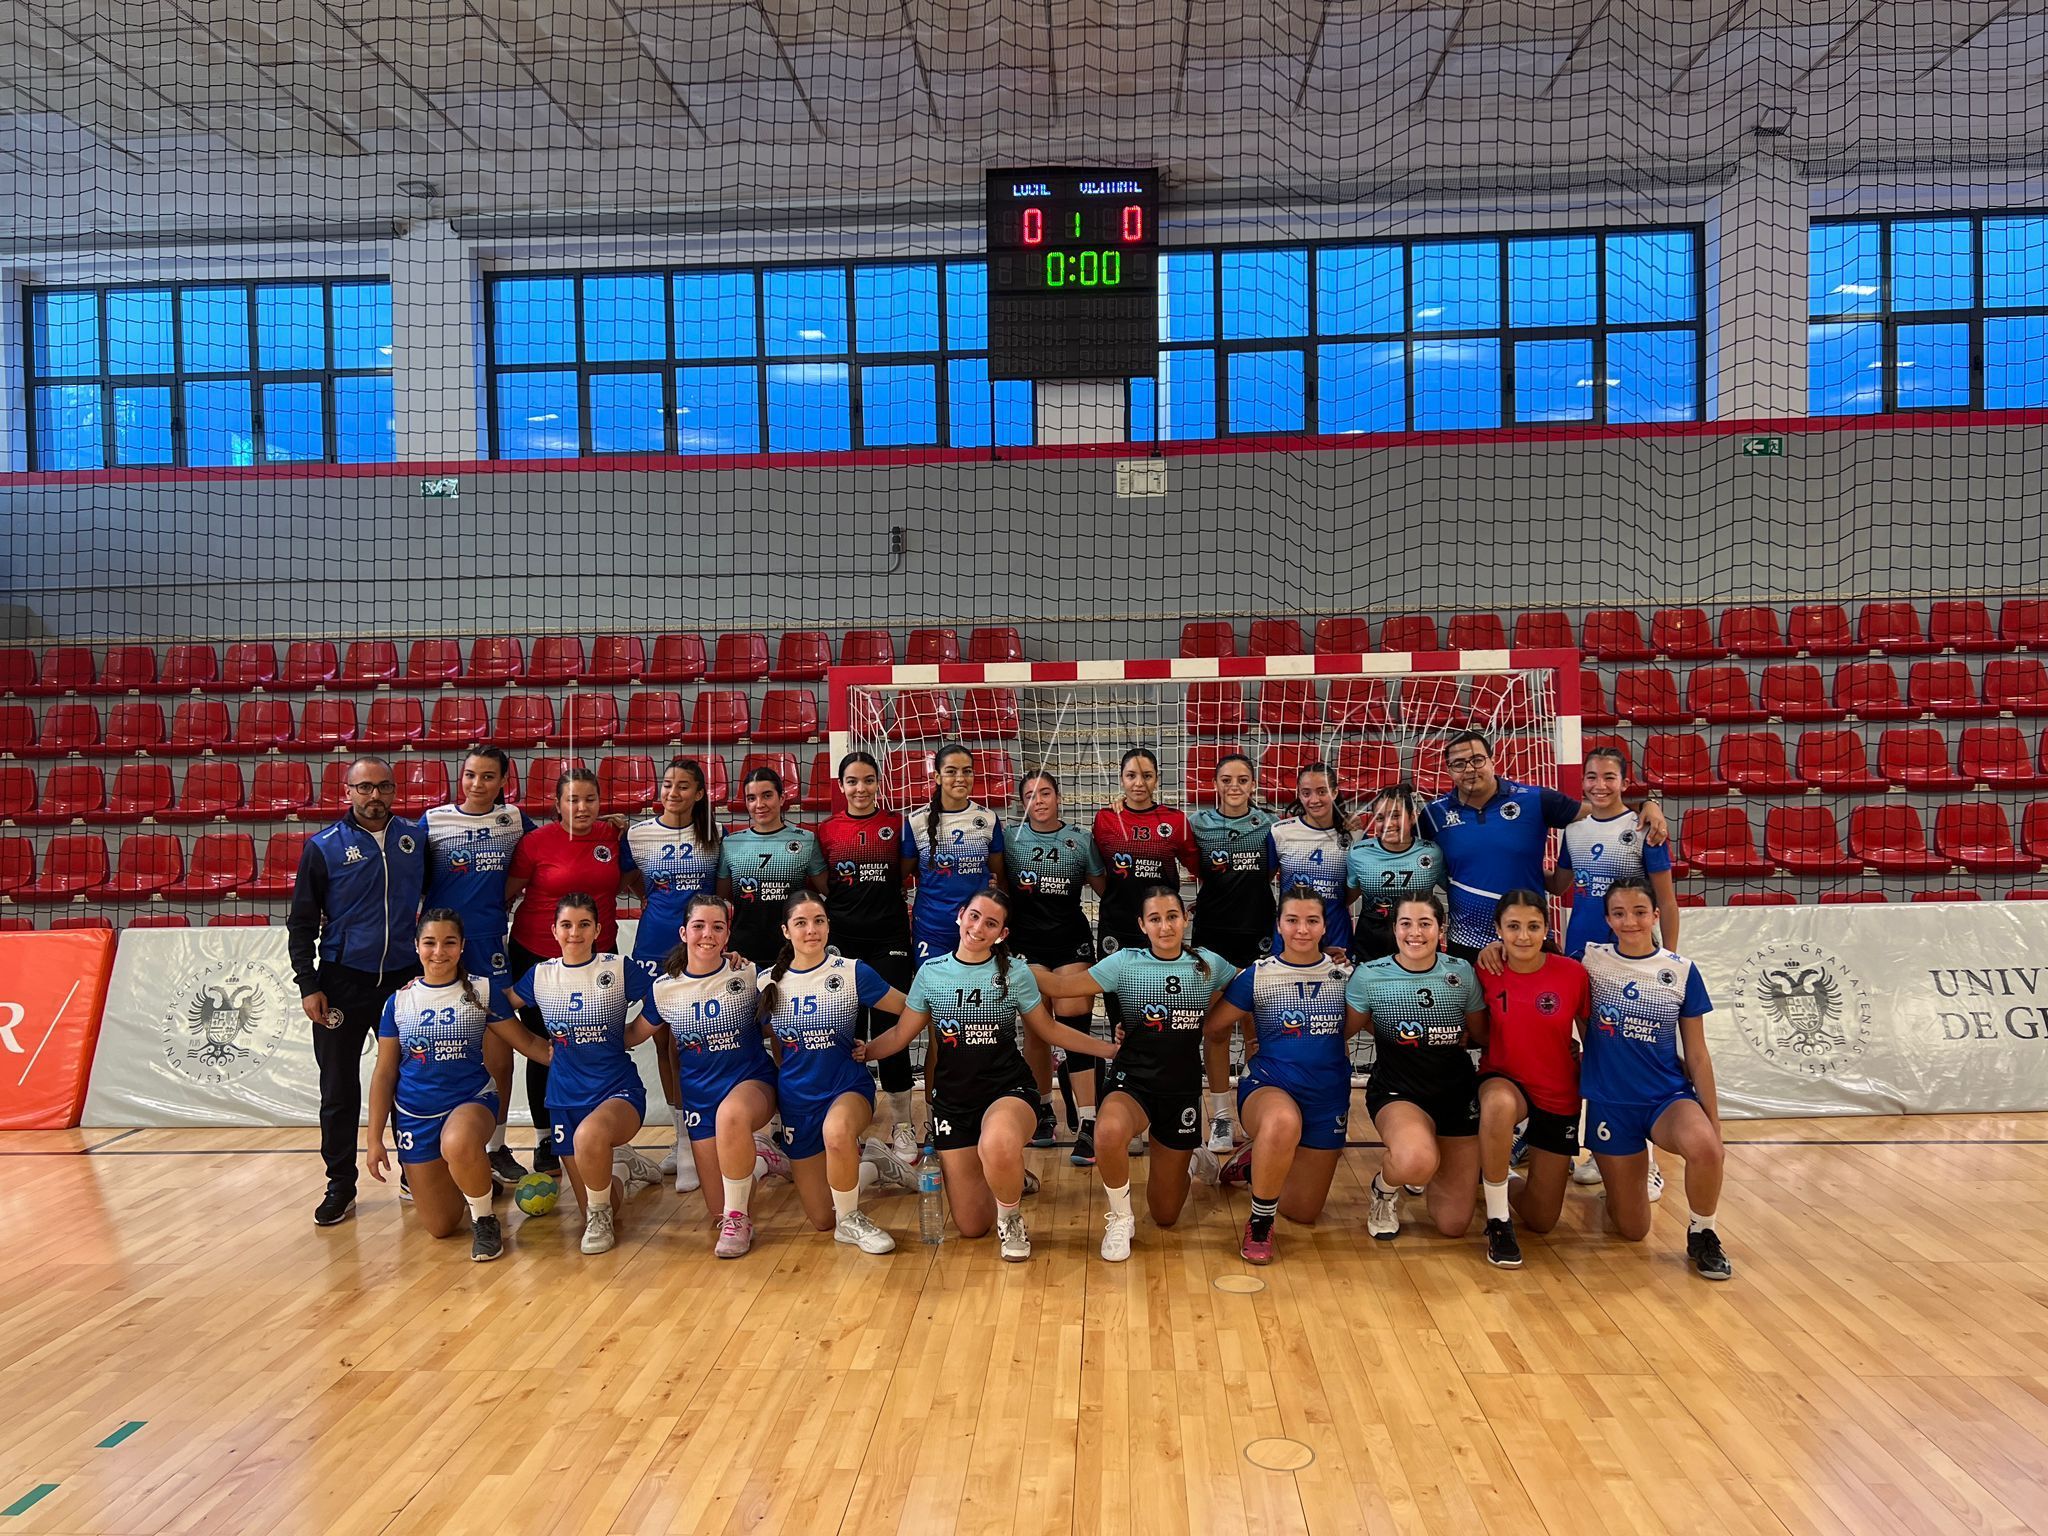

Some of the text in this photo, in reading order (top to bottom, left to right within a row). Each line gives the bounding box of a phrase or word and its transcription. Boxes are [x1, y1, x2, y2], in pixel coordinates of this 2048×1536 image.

[1023, 208, 1042, 243] 0
[1075, 211, 1080, 238] 1
[1123, 205, 1142, 240] 0
[1047, 251, 1120, 286] 0:00
[465, 827, 490, 842] 18
[858, 832, 867, 845] 1
[952, 830, 964, 845] 2
[1132, 826, 1150, 841] 13
[476, 852, 506, 860] MELILLA
[662, 843, 694, 862] 22
[1032, 848, 1060, 863] 24
[1308, 848, 1323, 866] 4
[1590, 844, 1604, 860] 9
[476, 858, 502, 866] SPORT
[476, 864, 504, 872] CAPITAL
[758, 854, 772, 870] 7
[1040, 876, 1070, 884] MELILLA
[1380, 870, 1414, 888] 27
[917, 941, 930, 958] 2
[1165, 976, 1182, 995] 8
[1928, 967, 2048, 998] UNIV
[1294, 981, 1324, 1000] 17
[1622, 981, 1640, 1000] 6
[568, 992, 584, 1012] 5
[955, 988, 982, 1008] 14
[1416, 988, 1435, 1009] 3
[1496, 990, 1508, 1013] 1
[690, 998, 721, 1020] 10
[791, 995, 818, 1016] 15
[420, 1007, 456, 1026] 23
[1172, 1016, 1200, 1024] SPORT
[1310, 1014, 1343, 1022] MELILLA
[1624, 1016, 1661, 1030] MELILLA
[574, 1024, 608, 1033] MELILLA
[964, 1024, 1000, 1032] MELILLA
[1171, 1022, 1200, 1030] CAPITAL
[1310, 1020, 1338, 1028] SPORT
[1310, 1027, 1340, 1035] CAPITAL
[1428, 1026, 1462, 1034] MELILLA
[1624, 1023, 1653, 1035] SPORT
[1937, 1011, 1998, 1040] DE
[574, 1030, 602, 1038] SPORT
[706, 1029, 740, 1040] MELILLA
[802, 1028, 836, 1037] MELILLA
[803, 1035, 830, 1044] SPORT
[965, 1030, 994, 1038] SPORT
[1428, 1032, 1458, 1040] SPORT
[1623, 1030, 1657, 1044] CAPITAL
[434, 1039, 468, 1048] MELILLA
[575, 1036, 608, 1044] CAPITAL
[708, 1036, 735, 1046] SPORT
[708, 1042, 741, 1052] CAPITAL
[804, 1040, 836, 1050] CAPITAL
[966, 1037, 998, 1046] CAPITAL
[434, 1046, 463, 1054] SPORT
[434, 1052, 468, 1061] CAPITAL
[934, 1116, 952, 1136] 14
[1597, 1121, 1612, 1142] 6
[554, 1124, 565, 1143] 5
